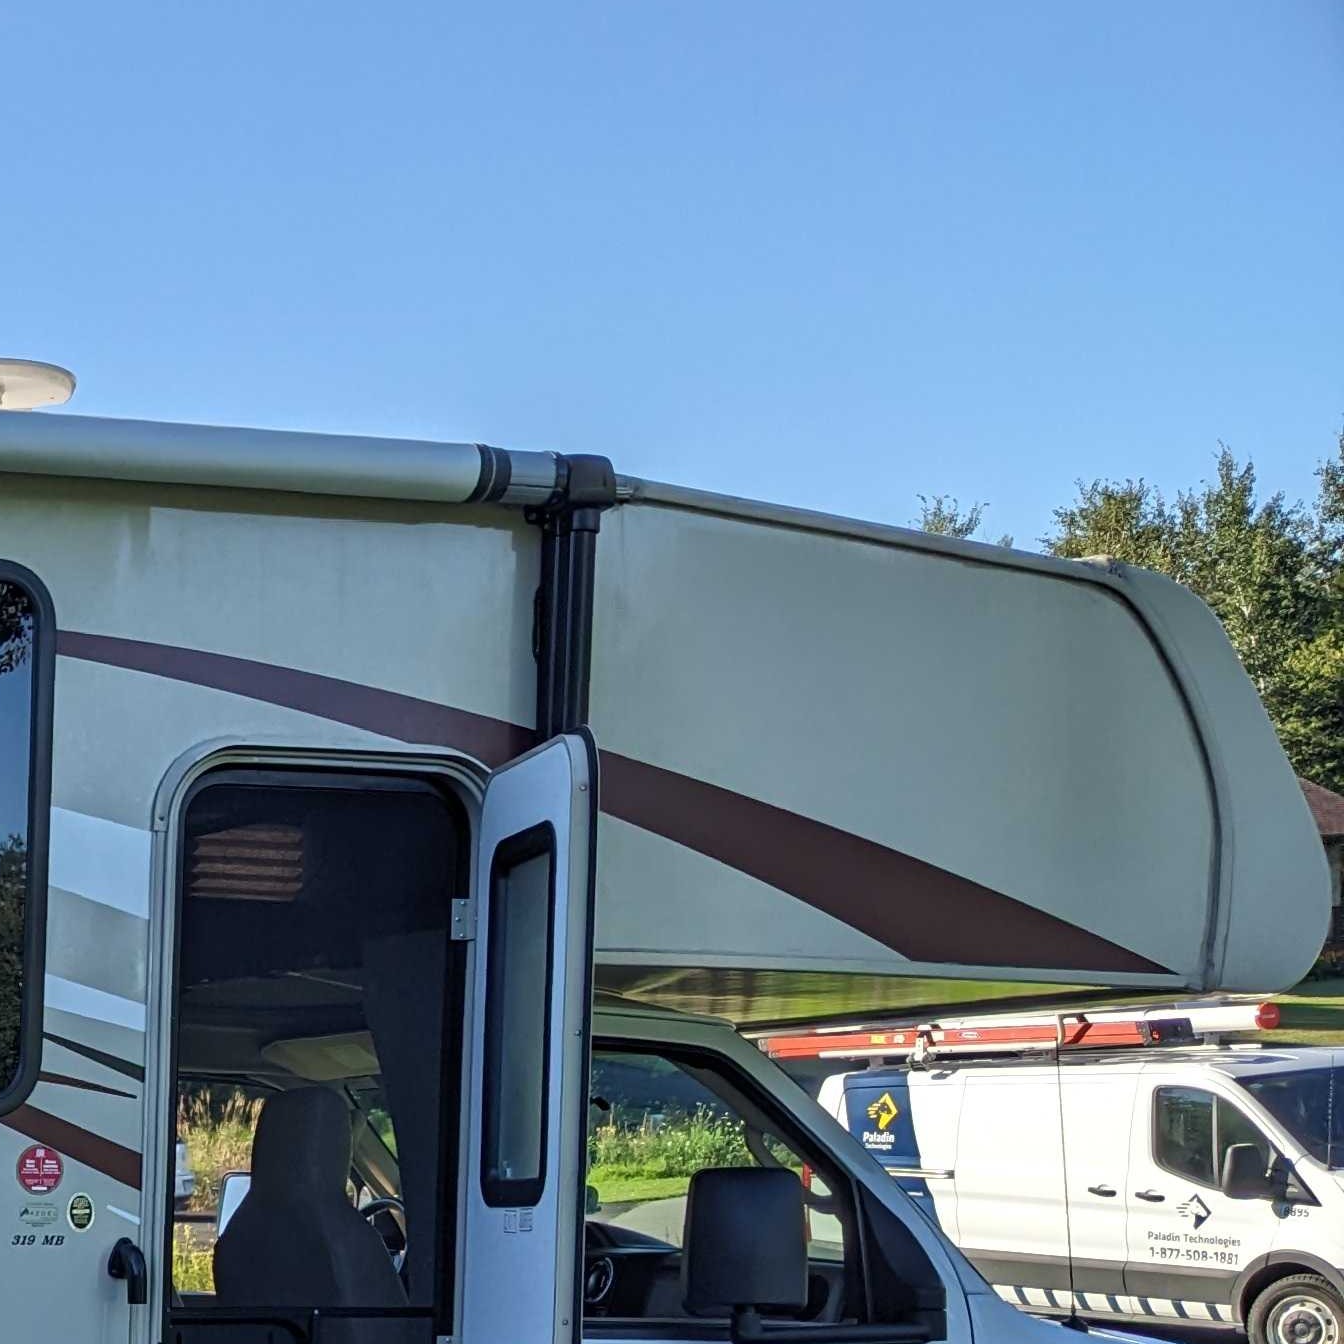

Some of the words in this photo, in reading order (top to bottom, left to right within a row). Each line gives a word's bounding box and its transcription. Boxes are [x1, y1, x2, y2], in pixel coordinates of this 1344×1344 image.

[863, 1131, 895, 1143] Paladin
[11, 1235, 36, 1246] 319
[41, 1235, 65, 1246] MB
[1148, 1231, 1180, 1242] Paladin
[1184, 1233, 1241, 1248] Technologies
[1149, 1246, 1239, 1265] 1-877-508-1881
